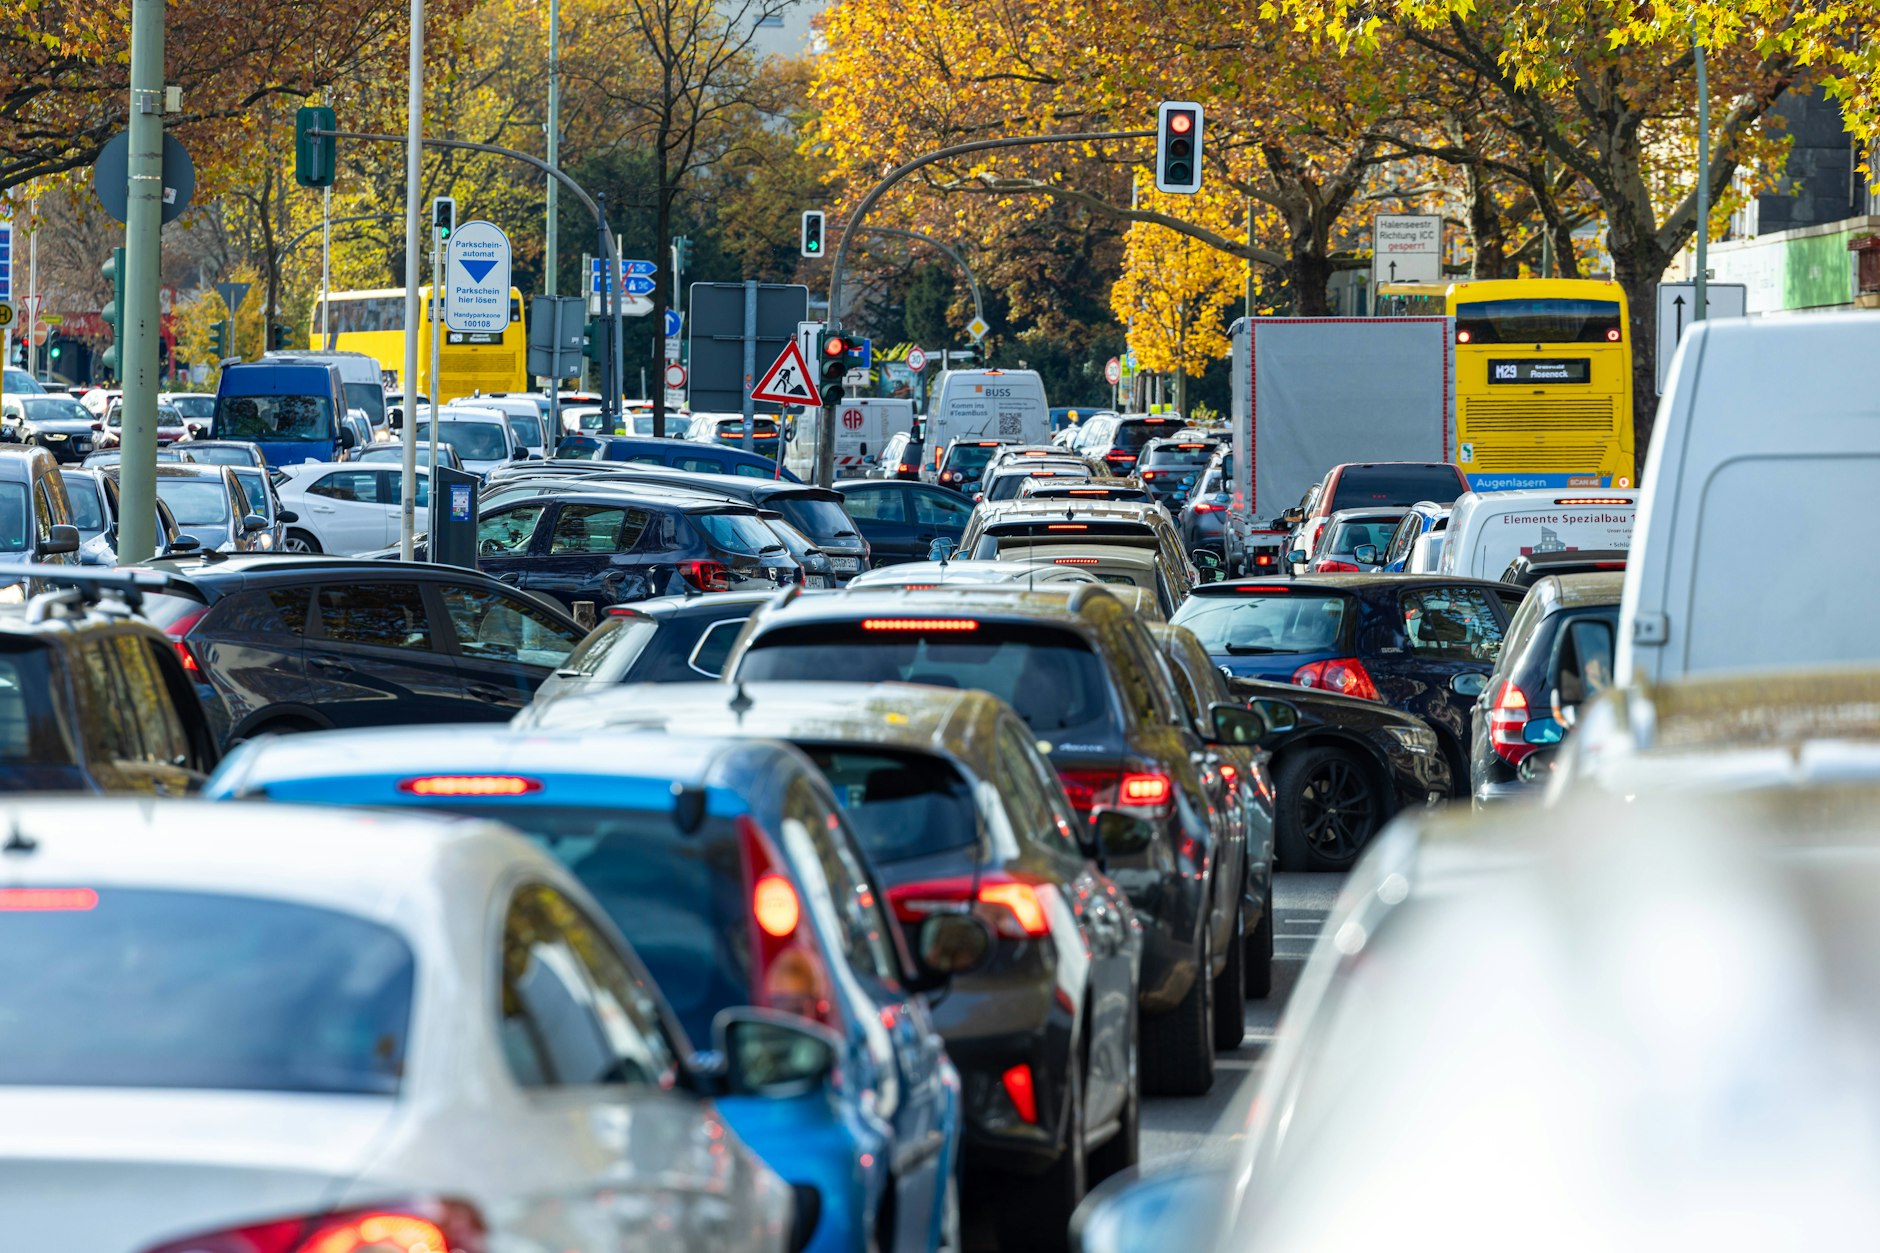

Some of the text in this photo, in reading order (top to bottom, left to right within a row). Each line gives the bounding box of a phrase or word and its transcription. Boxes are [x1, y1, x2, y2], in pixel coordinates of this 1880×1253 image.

[1380, 221, 1433, 229] Halenseestr.
[1379, 231, 1434, 241] Richtung ICC
[455, 241, 502, 249] Parkschein-
[1388, 242, 1425, 251] gesperrt
[456, 287, 500, 295] Parkschein
[475, 296, 497, 304] lösen
[463, 320, 491, 328] 100108
[1495, 365, 1517, 378] M29
[1530, 370, 1568, 378] Roseneck
[986, 388, 1011, 397] BUSS
[1476, 478, 1546, 488] Augenlasern
[1504, 515, 1558, 524] Elemente
[1562, 513, 1626, 525] Spezialbau
